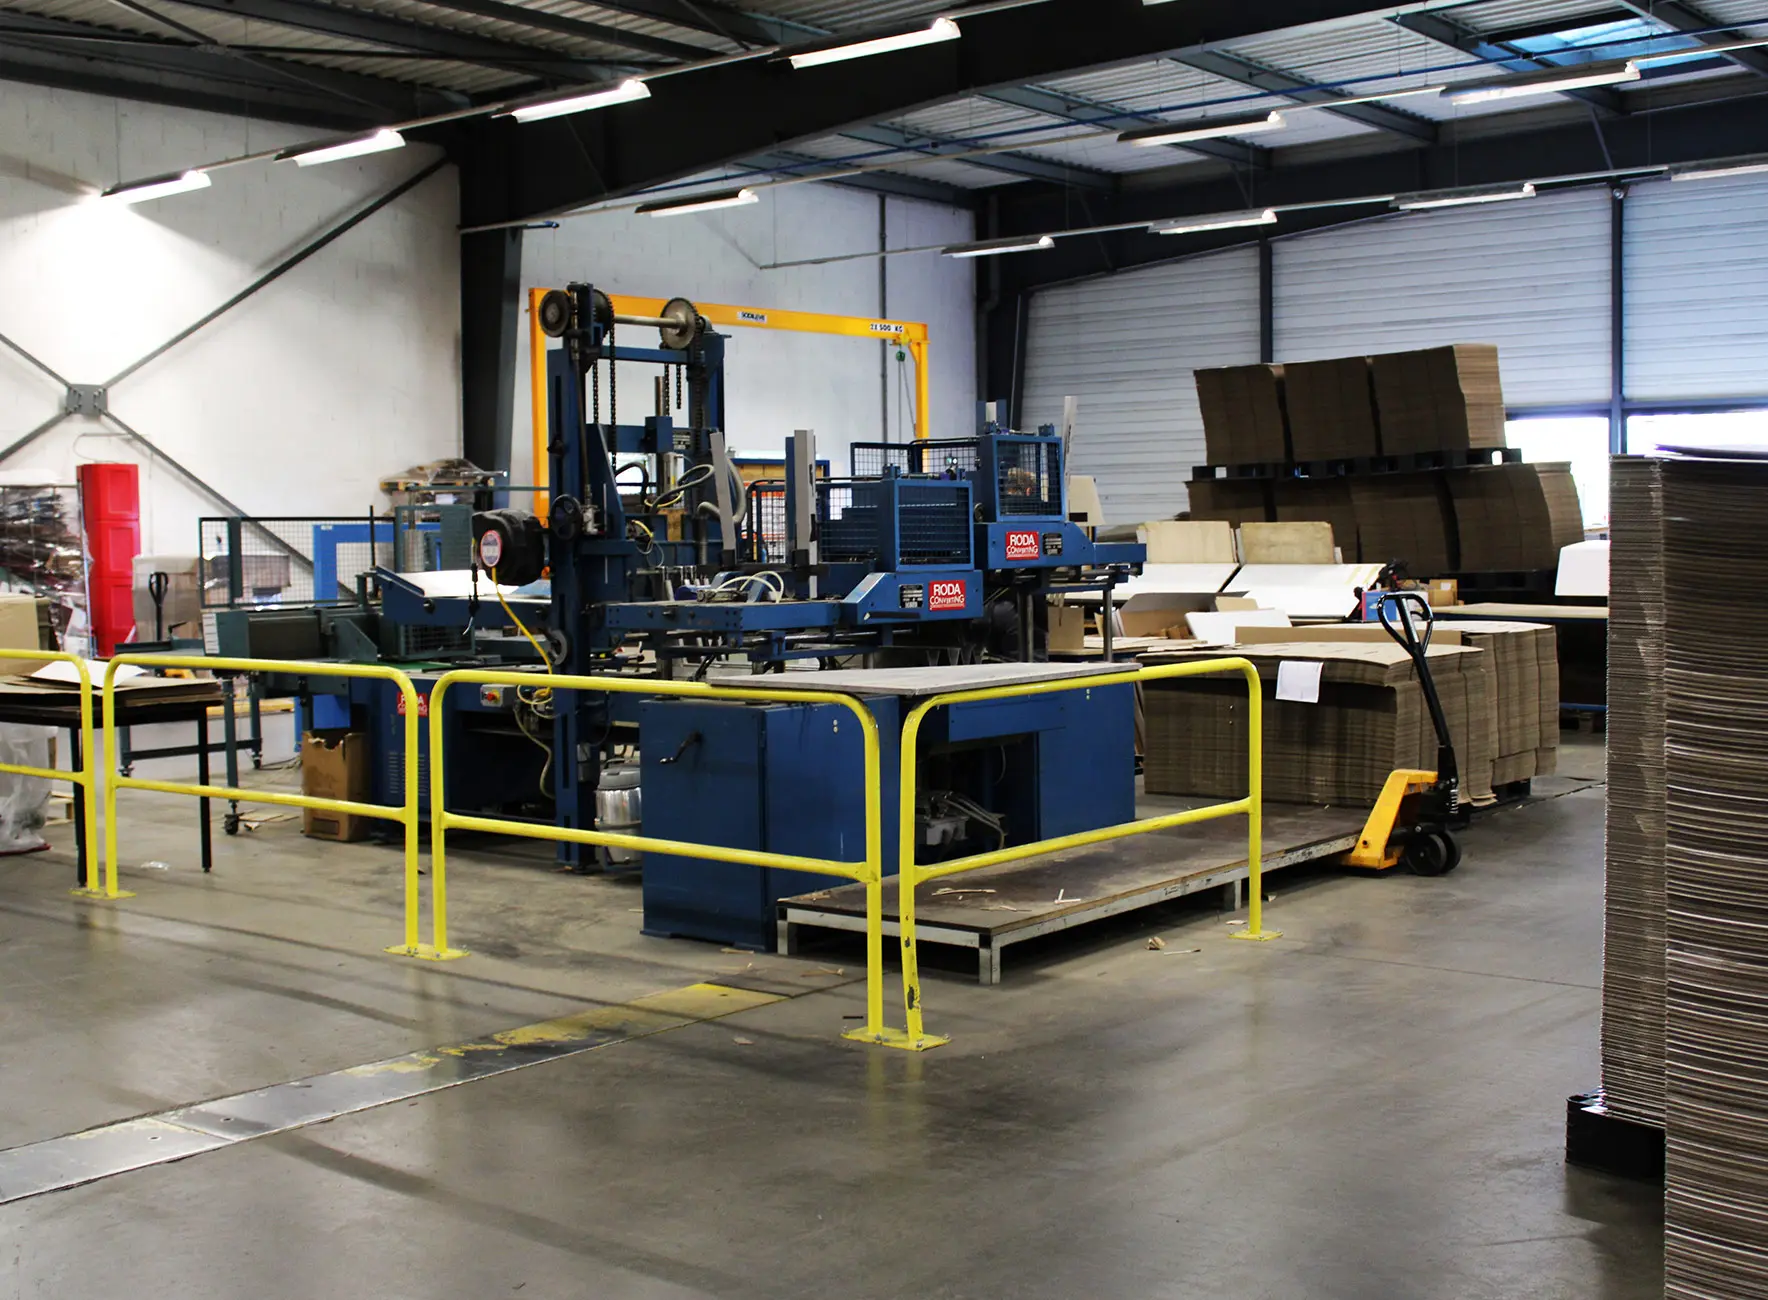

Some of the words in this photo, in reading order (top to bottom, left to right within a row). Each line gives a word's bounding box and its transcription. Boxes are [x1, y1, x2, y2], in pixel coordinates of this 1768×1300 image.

[1010, 534, 1035, 546] RODA
[1006, 545, 1038, 554] CONVERTING
[933, 583, 961, 596] RODA
[929, 594, 965, 605] CONVERTING
